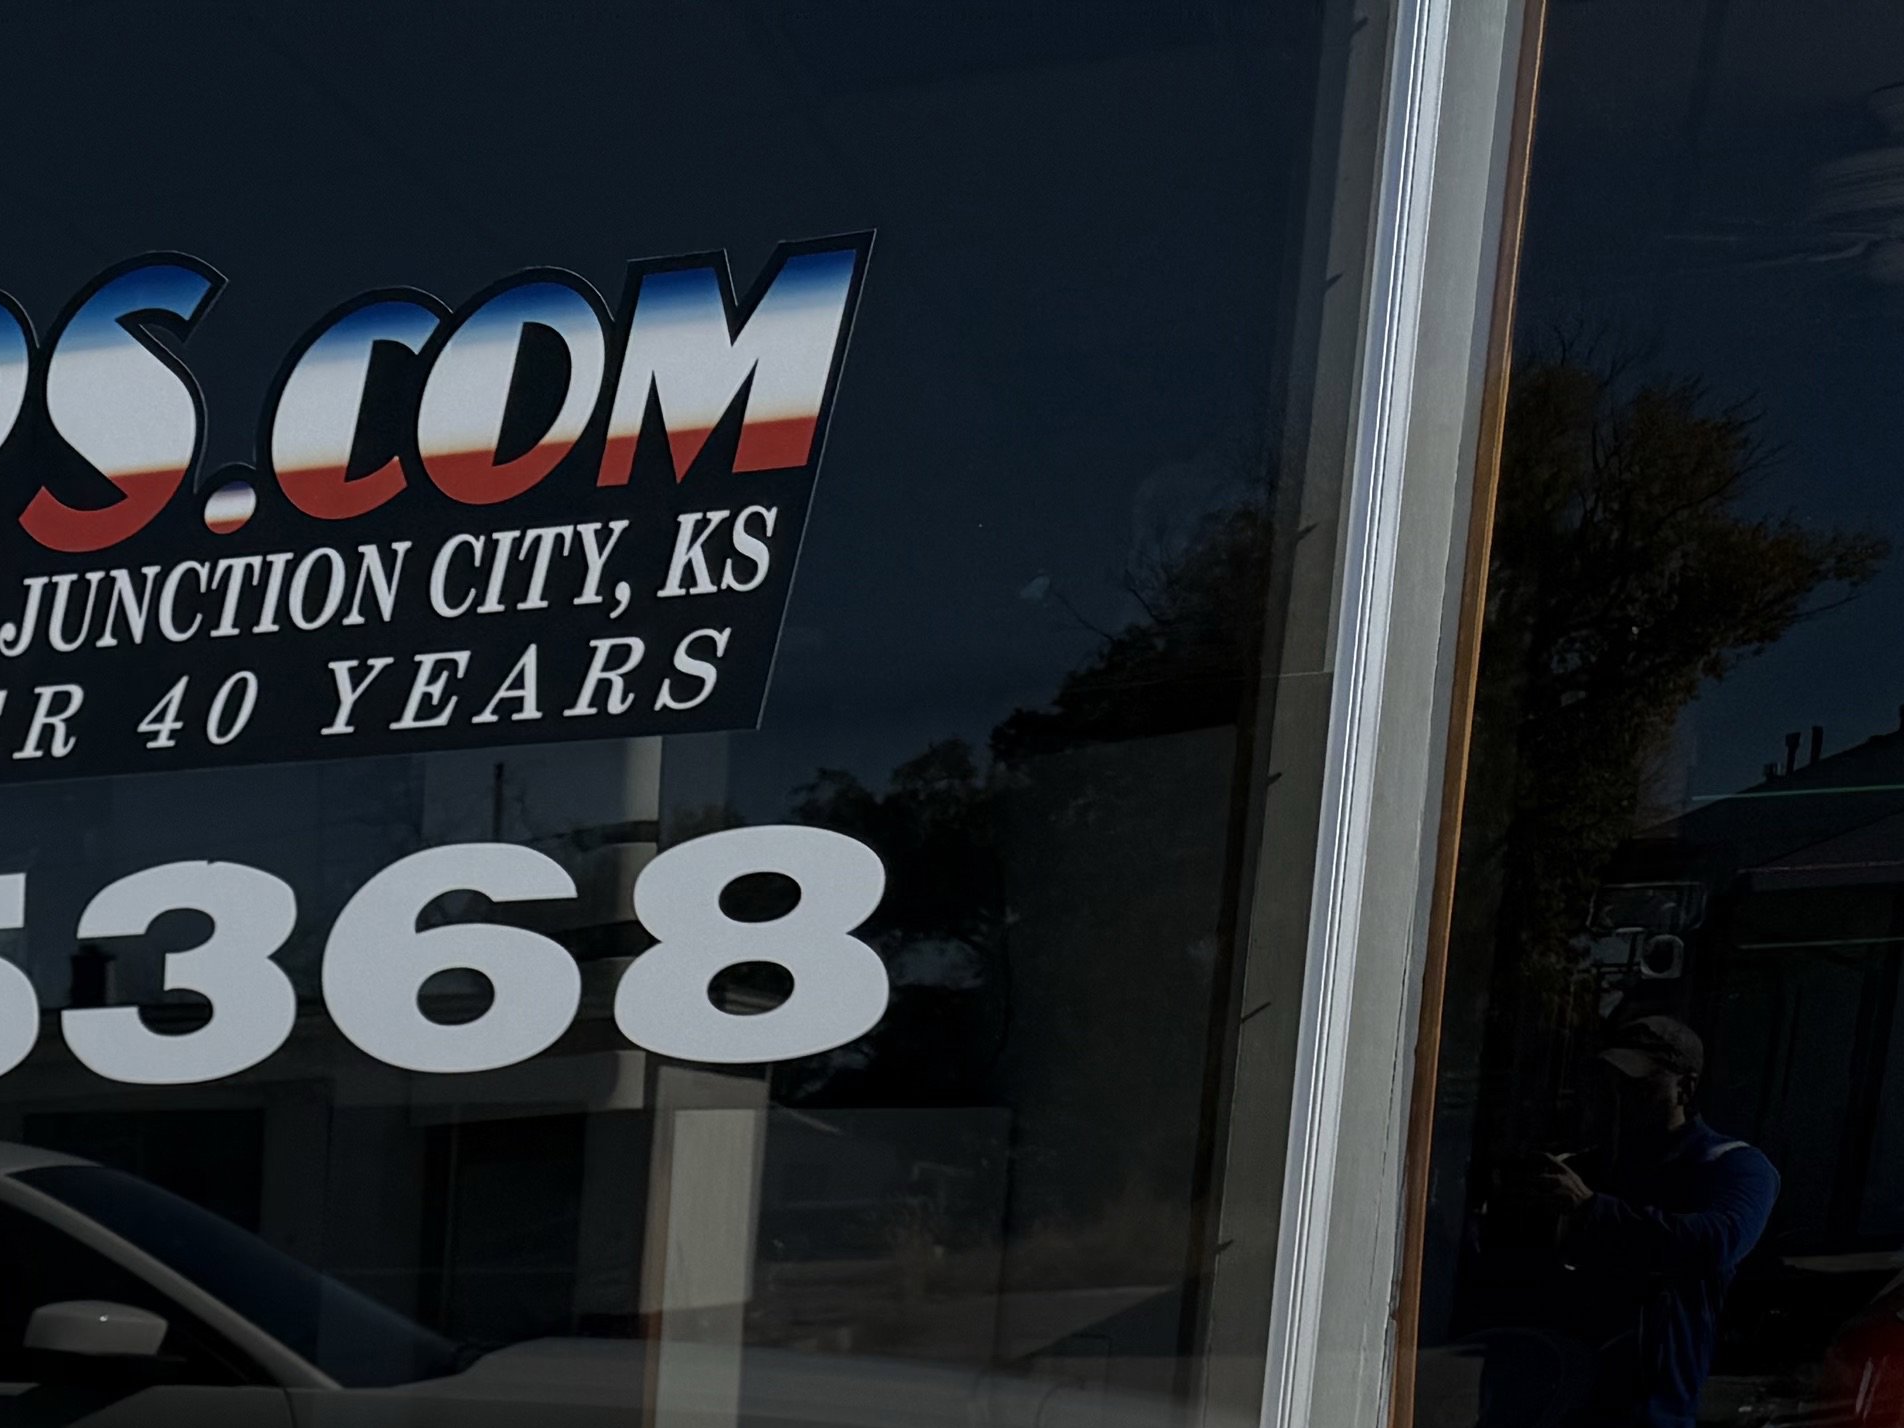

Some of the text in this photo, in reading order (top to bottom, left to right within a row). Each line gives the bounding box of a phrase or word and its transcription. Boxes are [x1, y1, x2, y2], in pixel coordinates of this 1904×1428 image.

[429, 520, 630, 620] CITY,
[656, 505, 780, 598] KS
[137, 670, 259, 748] 40
[320, 627, 732, 734] YEARS
